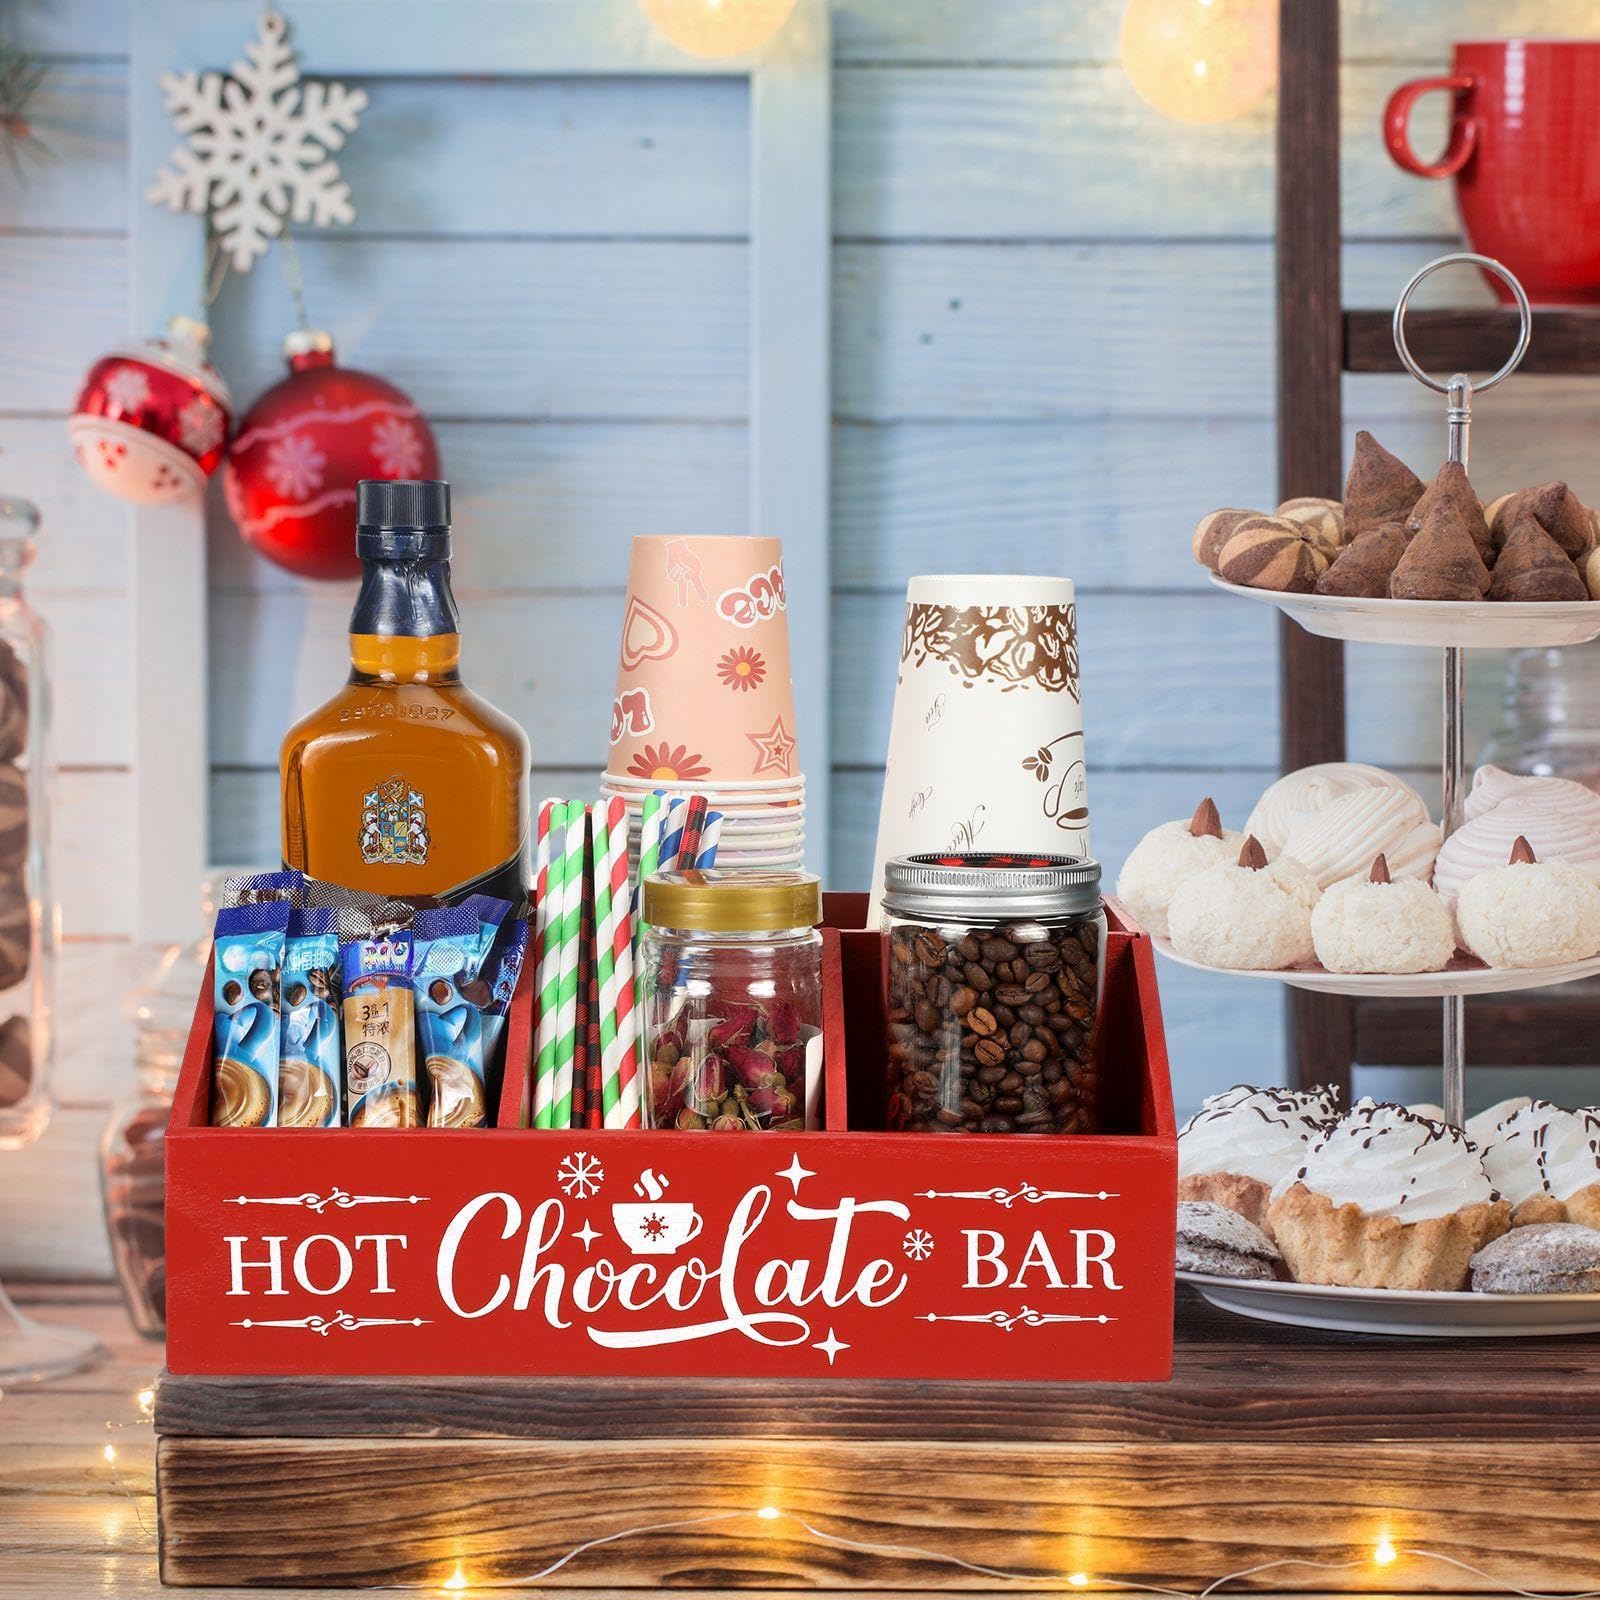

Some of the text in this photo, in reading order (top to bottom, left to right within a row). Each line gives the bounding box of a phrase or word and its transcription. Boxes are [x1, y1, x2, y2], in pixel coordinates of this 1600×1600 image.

[400, 702, 456, 721] 1827
[361, 1020, 390, 1038] 特浓
[223, 1183, 1124, 1350] HOT Chocolate BAR
